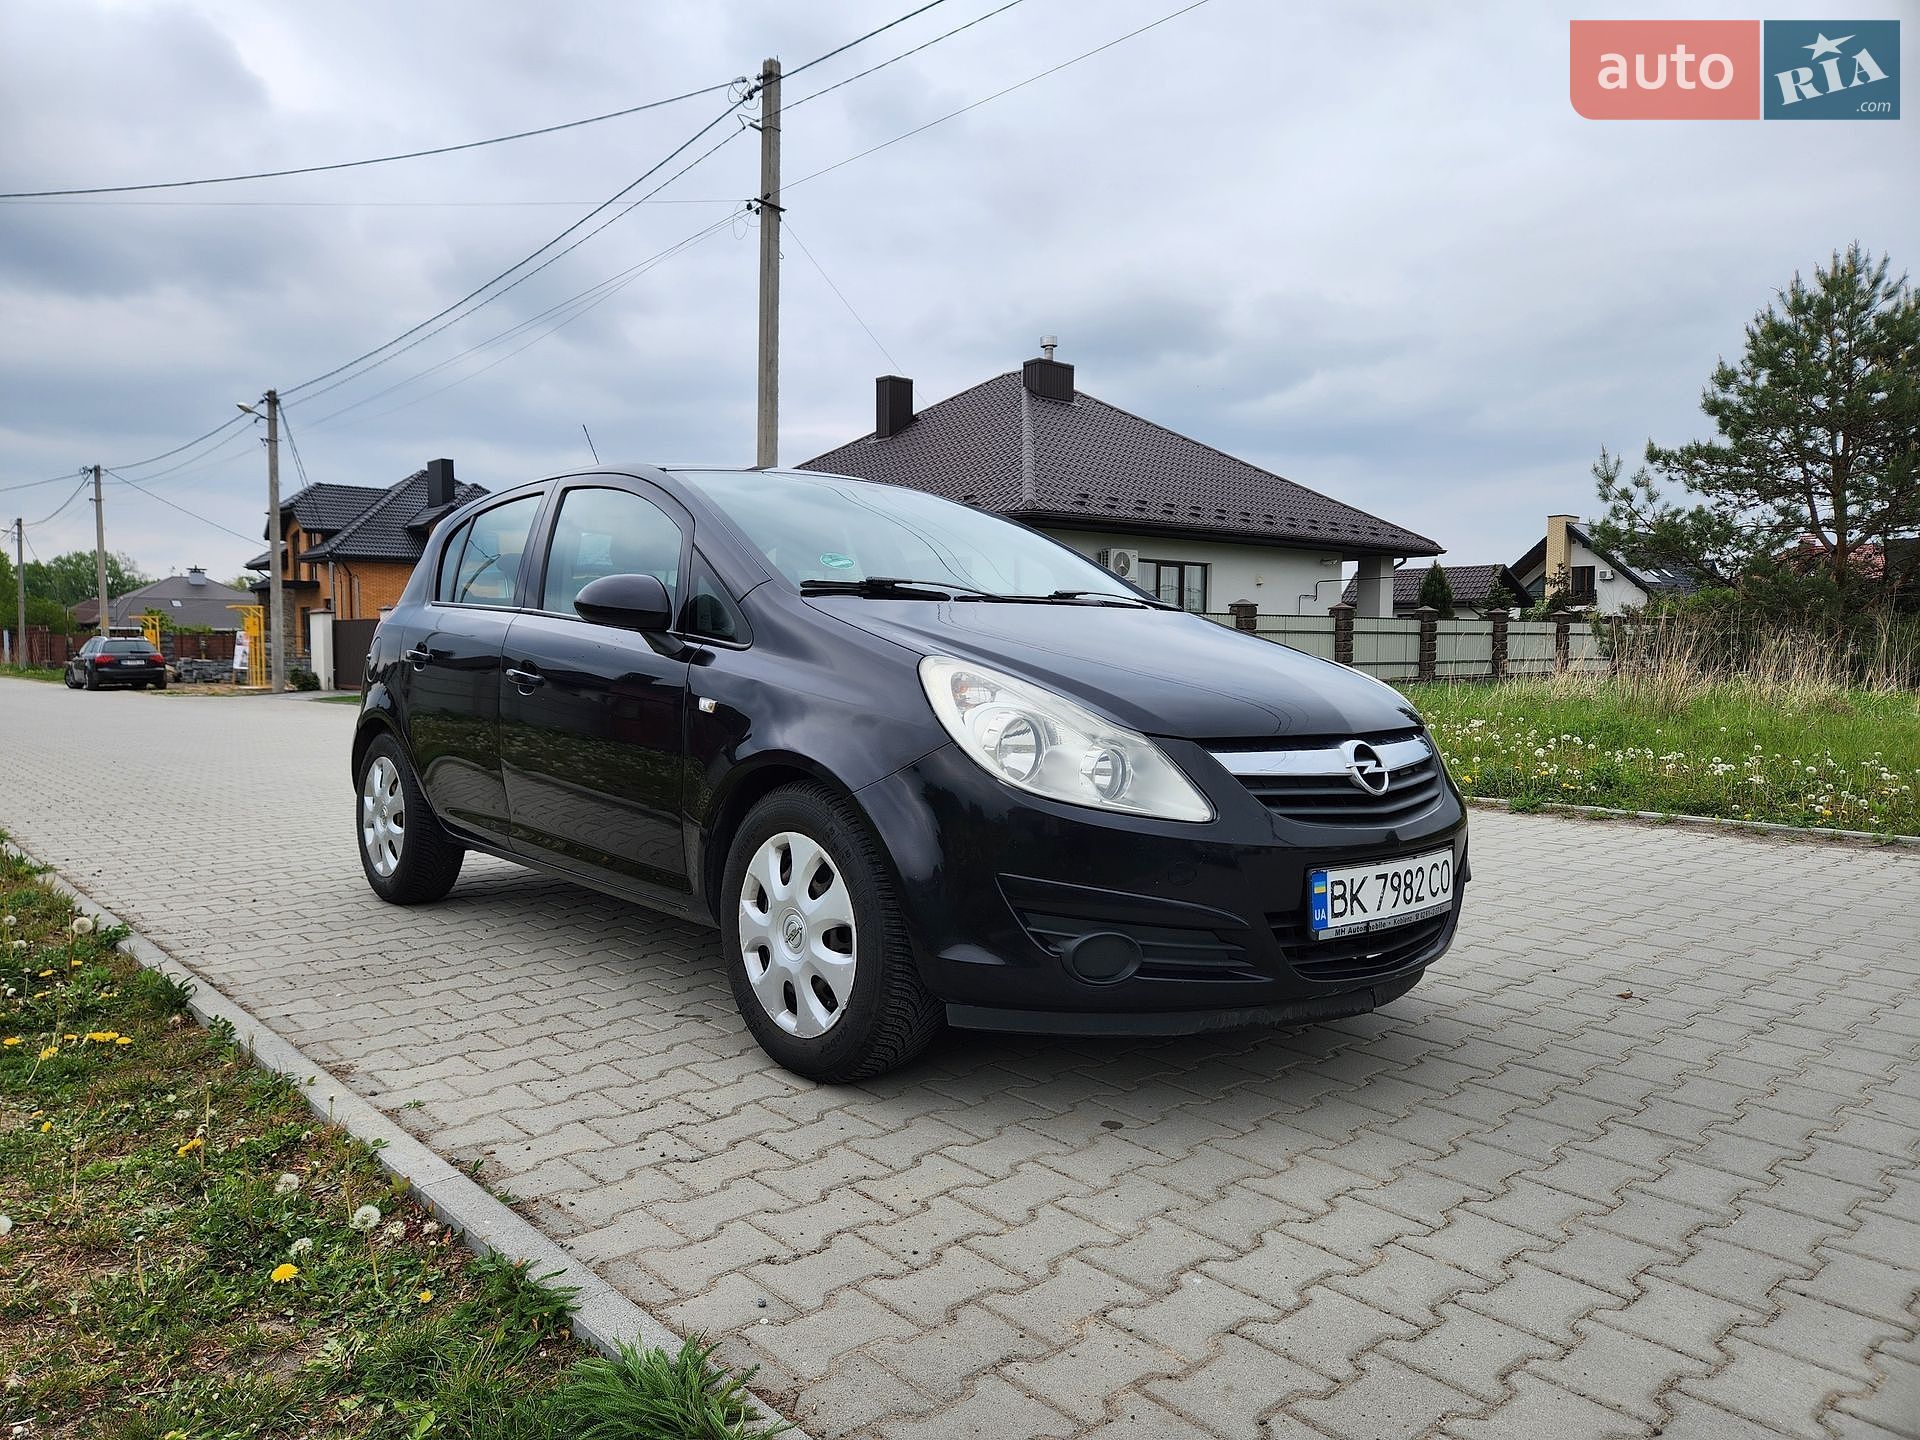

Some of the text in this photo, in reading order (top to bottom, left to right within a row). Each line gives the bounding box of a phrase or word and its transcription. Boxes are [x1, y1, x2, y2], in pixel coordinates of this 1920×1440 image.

[1330, 859, 1450, 919] BK 7982 CO
[1314, 908, 1327, 921] UA
[1334, 927, 1346, 937] MH
